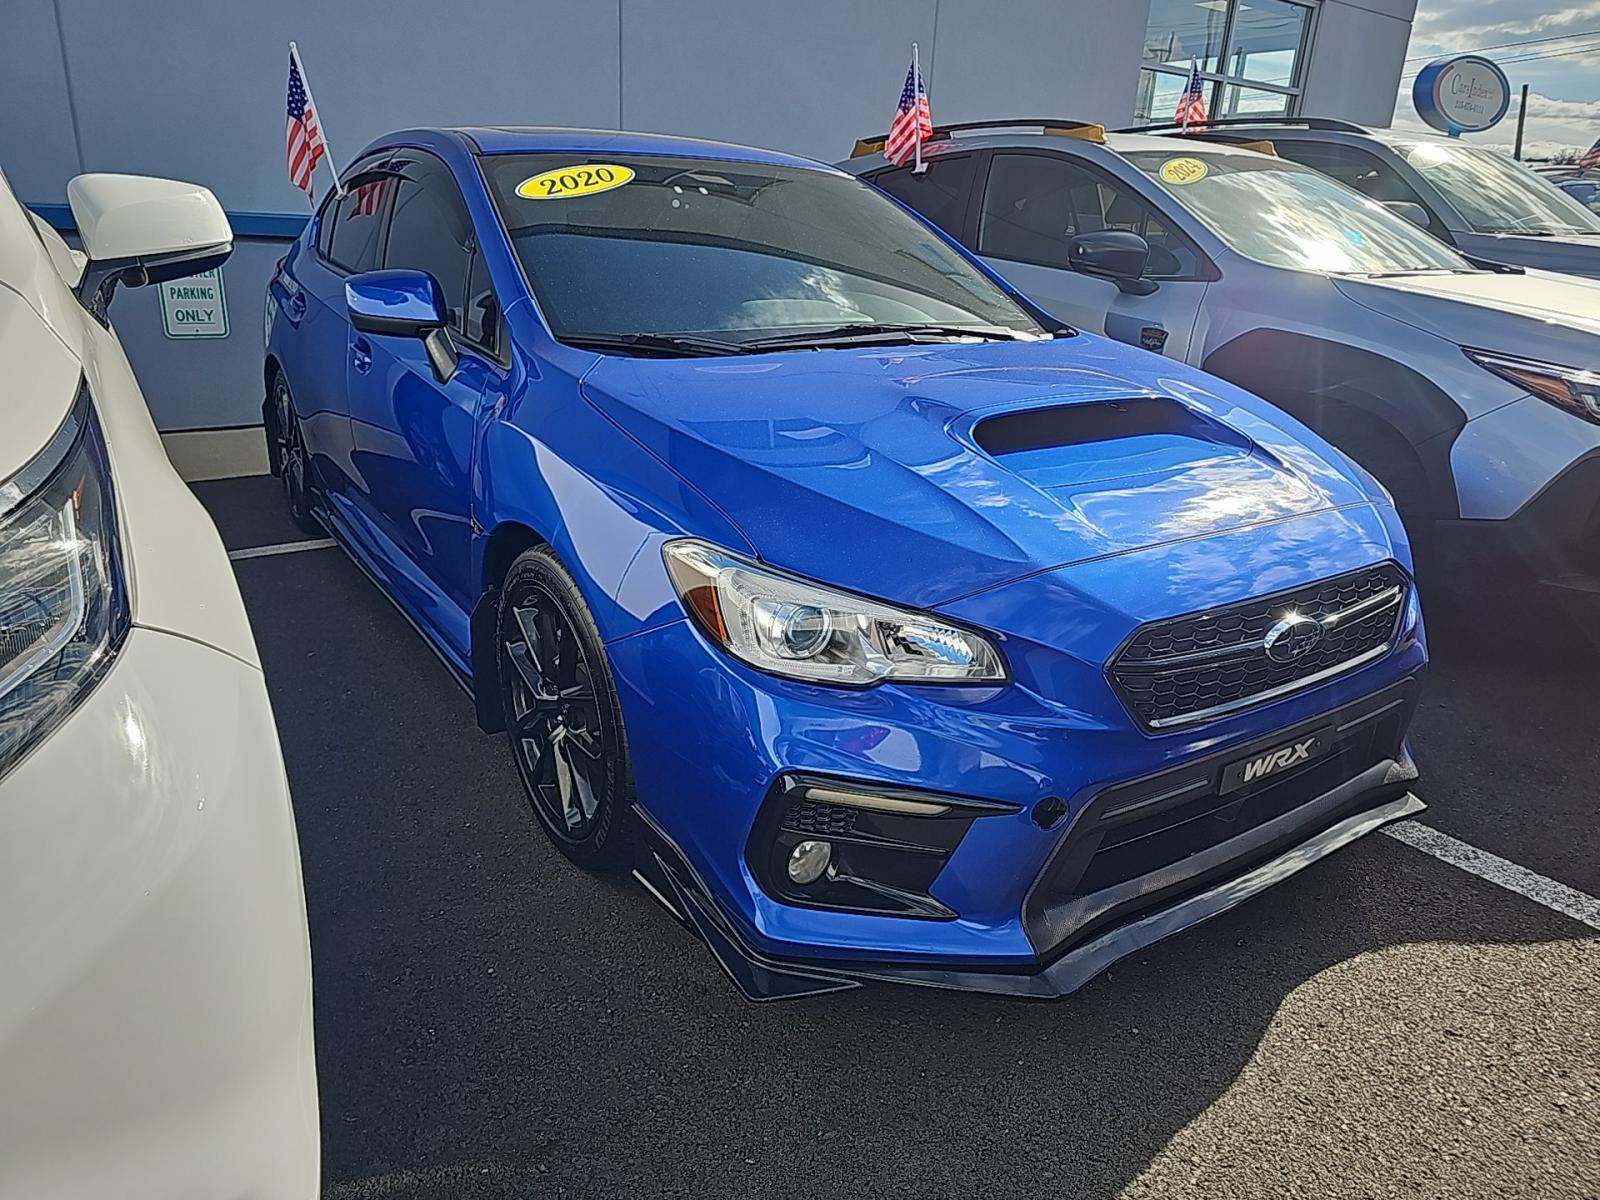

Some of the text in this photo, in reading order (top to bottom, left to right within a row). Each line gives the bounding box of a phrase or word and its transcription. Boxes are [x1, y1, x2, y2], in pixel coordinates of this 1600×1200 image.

[540, 167, 614, 195] 2020
[1168, 159, 1202, 181] 2024
[169, 287, 214, 300] PARKING
[175, 309, 214, 322] ONLY
[1244, 737, 1315, 782] WRX
